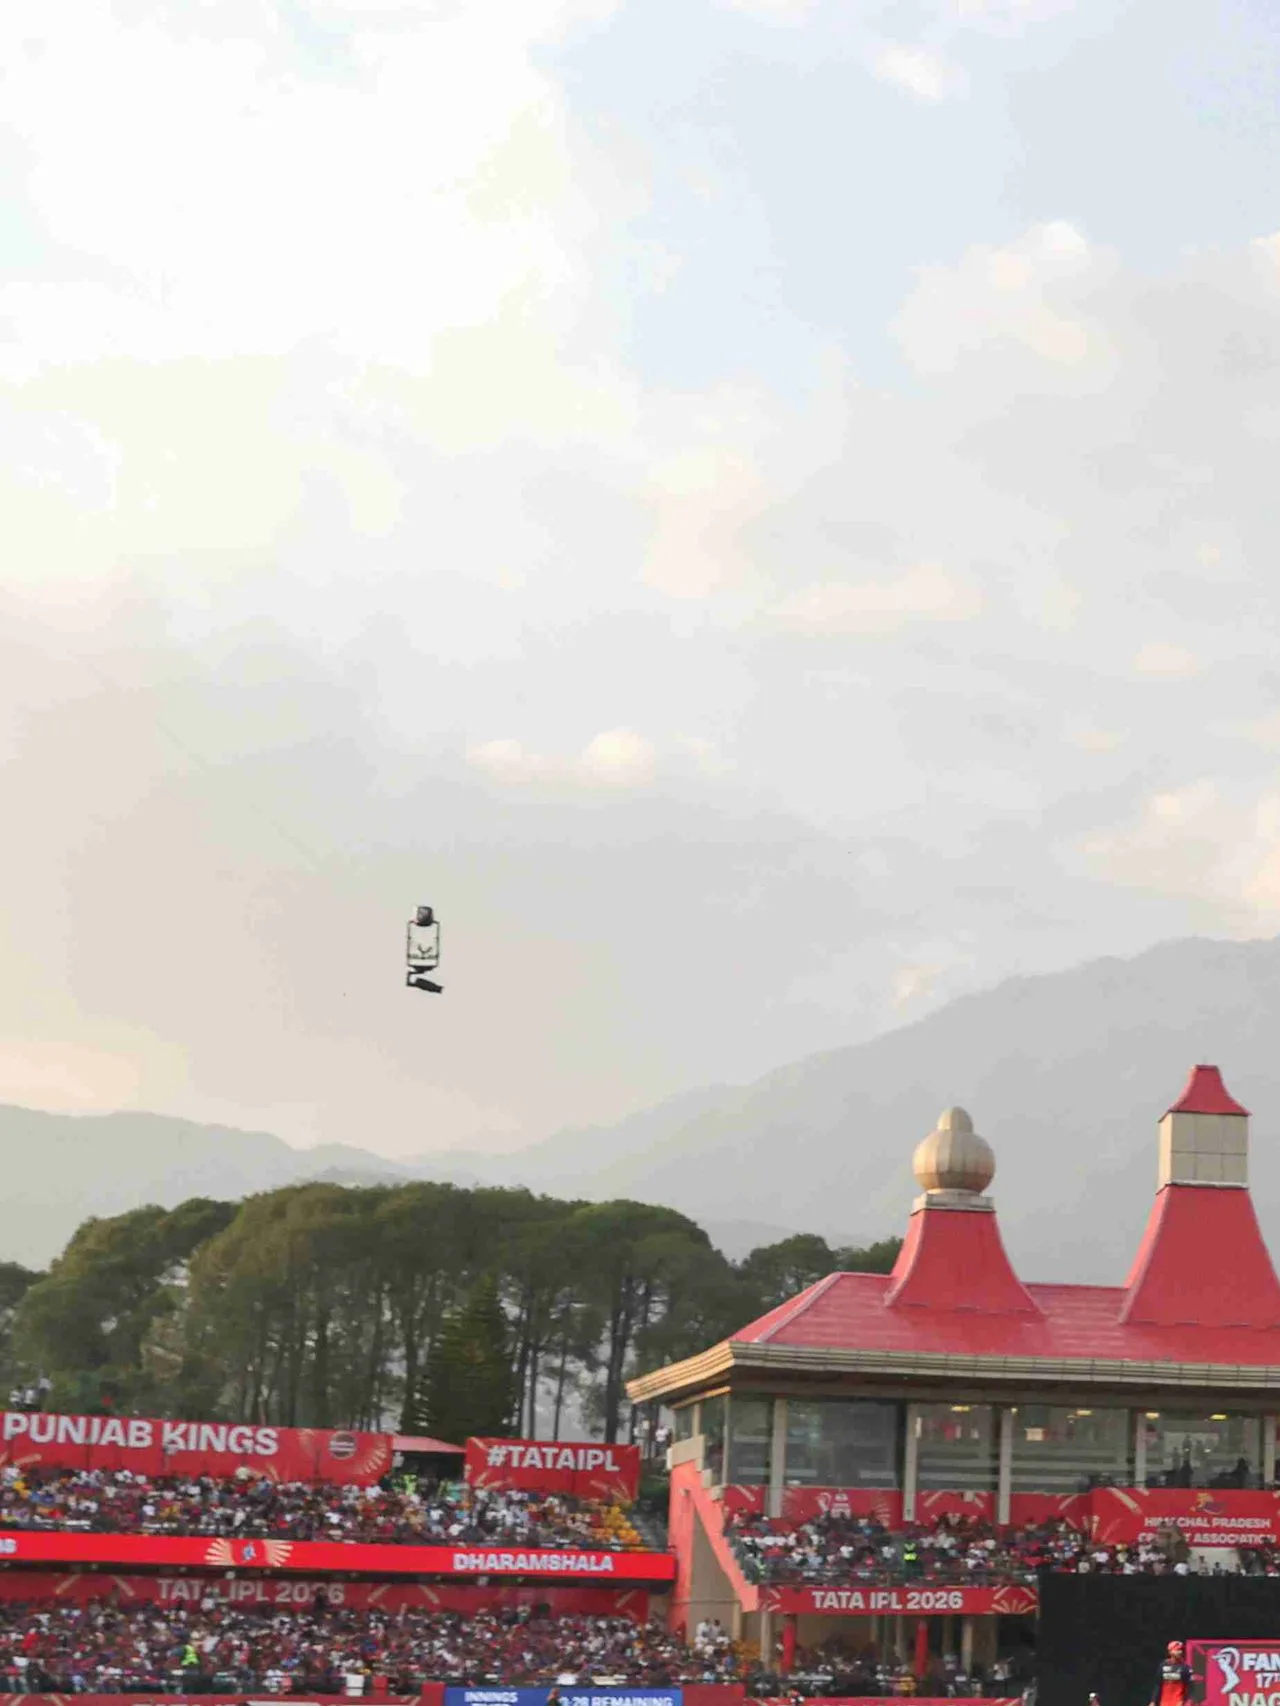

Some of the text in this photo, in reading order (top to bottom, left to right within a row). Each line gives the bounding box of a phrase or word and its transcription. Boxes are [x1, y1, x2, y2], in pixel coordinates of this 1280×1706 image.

[3, 1412, 279, 1456] PUNJAB KINGS
[487, 1445, 620, 1472] #TATAIPL
[1144, 1517, 1271, 1528] HICHAL PRADESH
[453, 1554, 613, 1571] DHARAMSHALA
[157, 1579, 221, 1600] TAT
[229, 1581, 269, 1601] IPL
[811, 1591, 963, 1609] TATA IPL 2026
[464, 1691, 517, 1703] INNINGS
